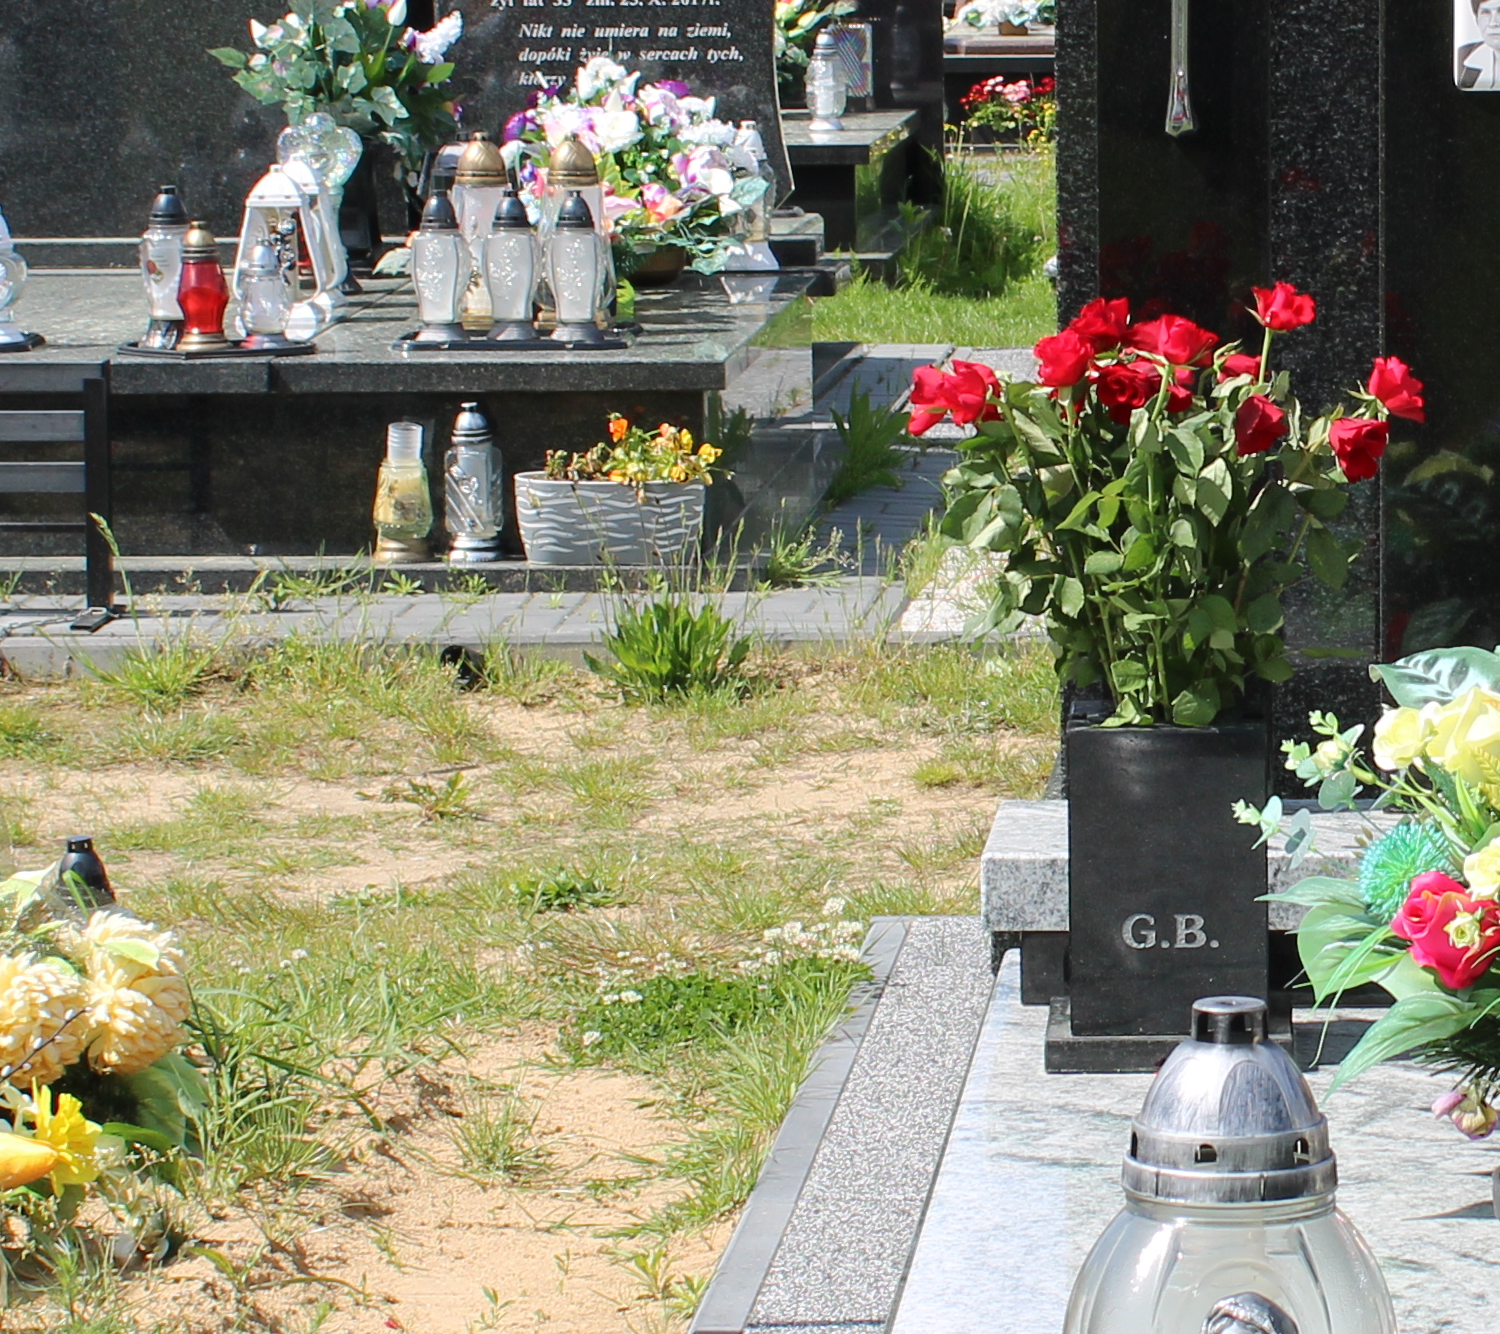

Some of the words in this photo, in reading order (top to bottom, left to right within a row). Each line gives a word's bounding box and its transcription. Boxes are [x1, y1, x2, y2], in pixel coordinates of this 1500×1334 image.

[518, 23, 554, 39] Nikt
[560, 23, 586, 39] nie
[594, 23, 650, 39] umiera
[657, 27, 678, 38] na
[686, 23, 732, 39] ziemi,
[518, 46, 571, 64] dopóki
[617, 50, 632, 61] w
[638, 47, 698, 61] sercach
[706, 47, 744, 63] tych,
[1122, 912, 1220, 950] G.B.
